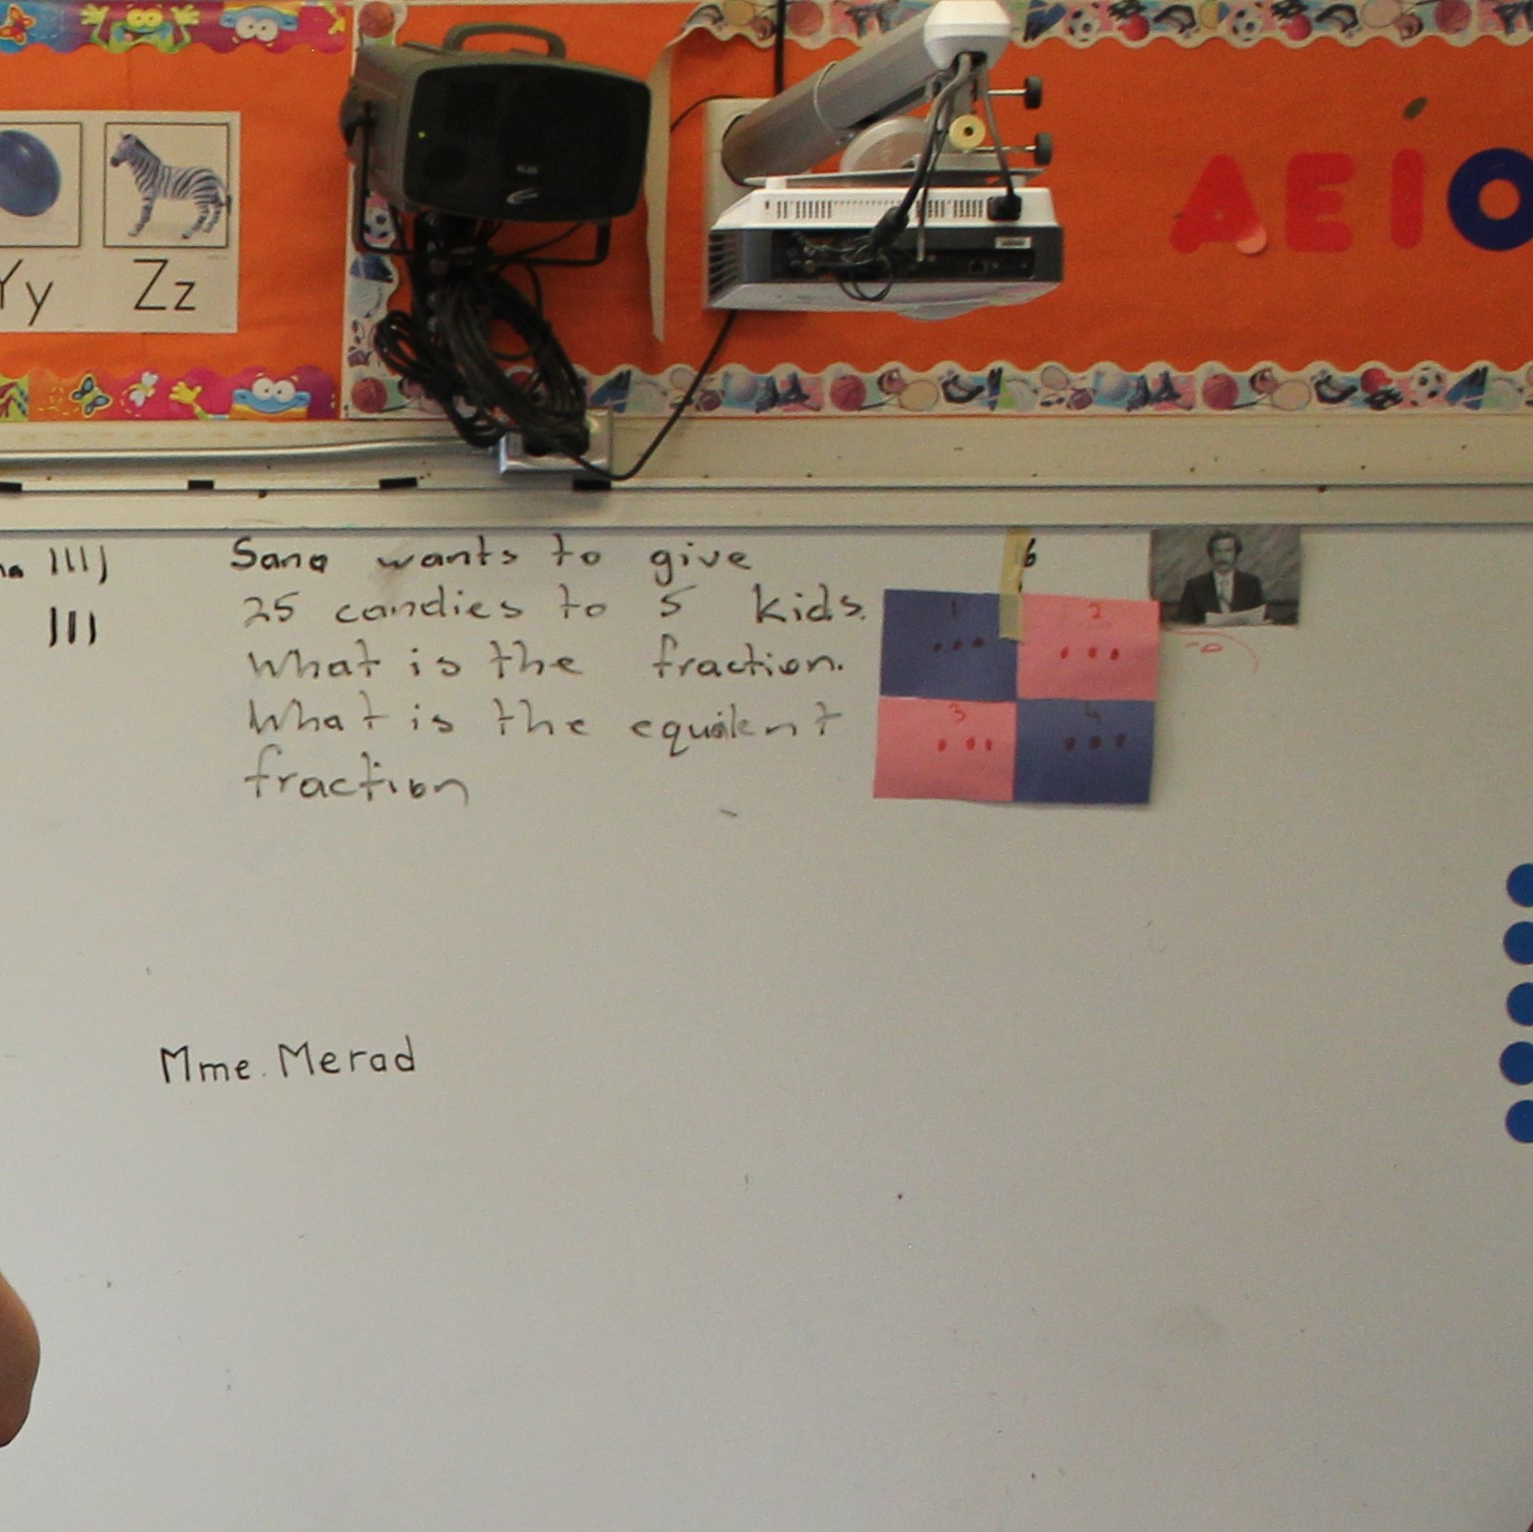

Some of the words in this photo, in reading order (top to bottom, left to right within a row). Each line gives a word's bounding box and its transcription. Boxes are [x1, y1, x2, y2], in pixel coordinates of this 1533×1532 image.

[133, 258, 197, 312] Zz
[230, 535, 329, 574] Sana
[377, 534, 520, 572] wants
[548, 531, 605, 567] to
[648, 541, 752, 587] give
[243, 590, 300, 628] 25
[334, 585, 524, 625] candies
[558, 582, 608, 620] to
[658, 584, 697, 619] 5
[247, 637, 382, 680] What
[409, 647, 462, 678] is
[489, 639, 583, 678] the
[652, 632, 844, 679] fraction.
[248, 689, 386, 736] What
[411, 703, 454, 734] is
[492, 696, 588, 737] the
[243, 744, 470, 805] fraction
[277, 1034, 416, 1079] Merad
